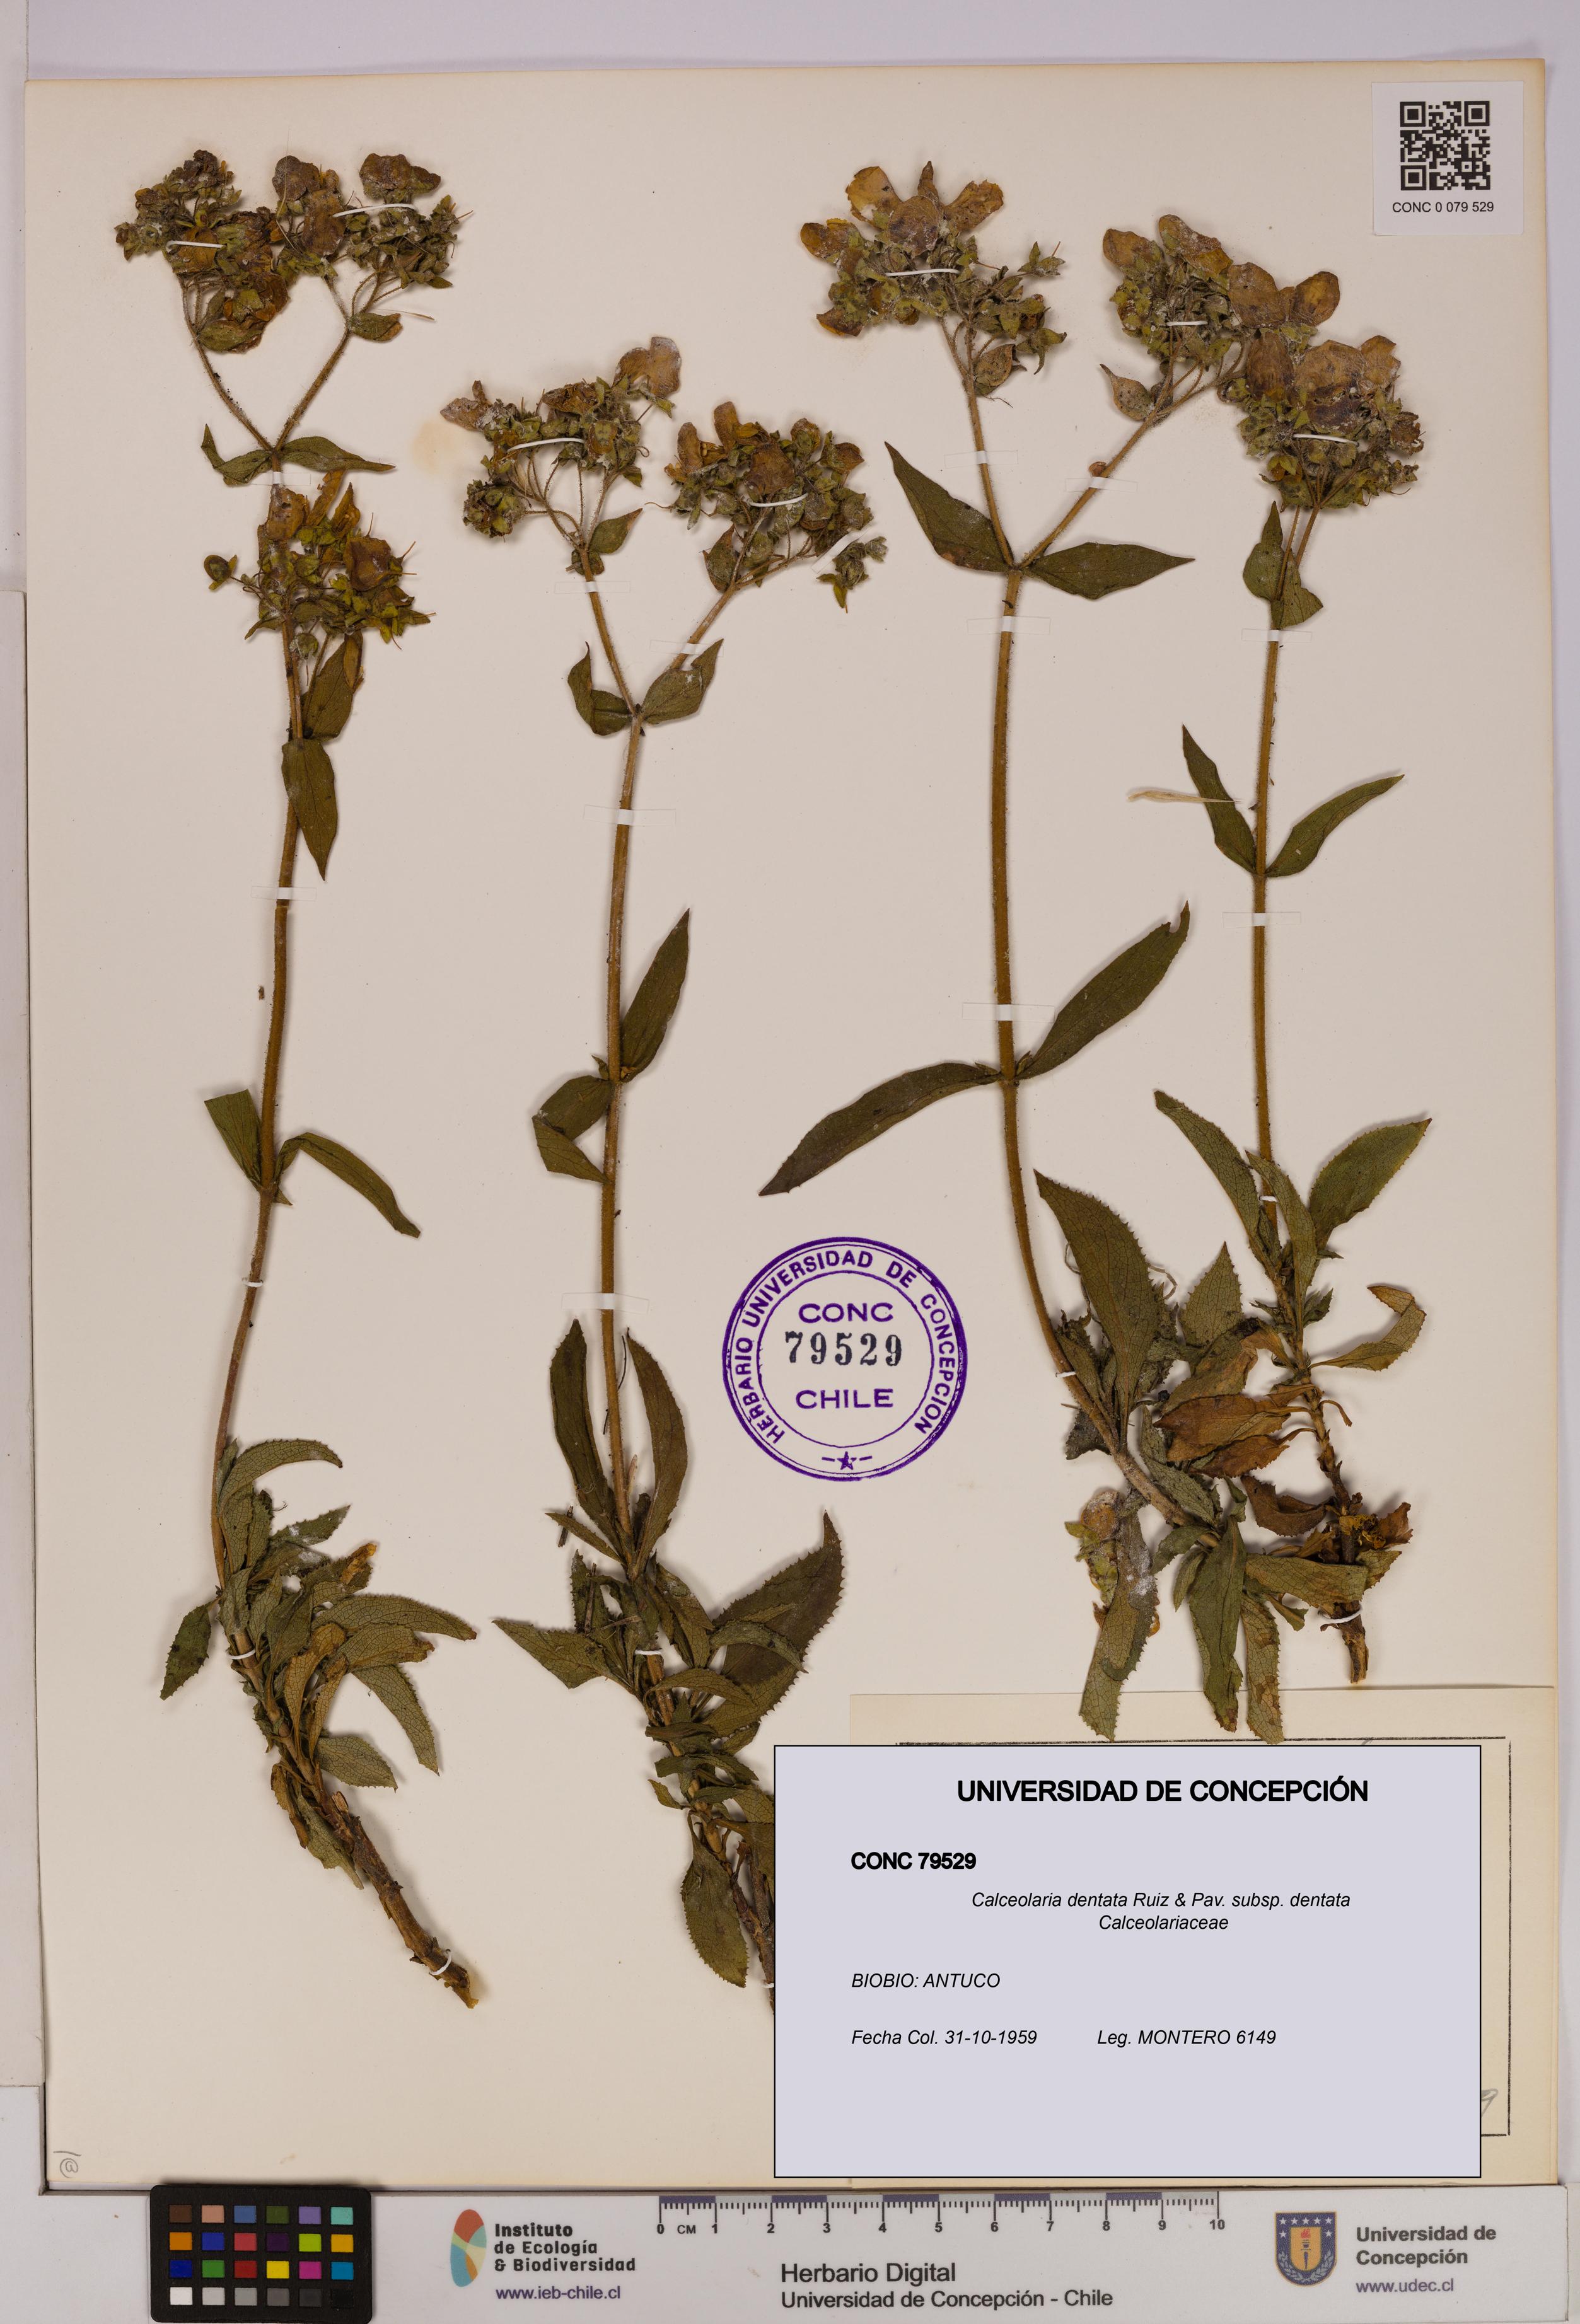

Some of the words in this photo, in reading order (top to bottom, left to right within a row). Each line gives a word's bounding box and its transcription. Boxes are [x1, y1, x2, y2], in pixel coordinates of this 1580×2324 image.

[1393, 202, 1431, 212] CONC
[1436, 202, 1442, 212] 0
[1447, 202, 1468, 212] 079
[1472, 202, 1494, 212] 529
[886, 1261, 917, 1288] DE
[742, 1250, 873, 1327] UNIVERSIDAD
[799, 1303, 893, 1323] CONC
[785, 1331, 902, 1367] 79529
[914, 1293, 955, 1433] CONCEPCION
[736, 1337, 785, 1443] HERBARIO
[796, 1389, 893, 1409] CHILE
[496, 2223, 572, 2236] Instituto
[657, 2224, 665, 2234] 0
[677, 2225, 695, 2234] CM
[712, 2223, 717, 2233] 1
[767, 2223, 774, 2233] 2
[823, 2223, 830, 2233] 3
[878, 2223, 886, 2233] 4
[935, 2223, 943, 2233] 5
[991, 2222, 998, 2232] 6
[1047, 2221, 1054, 2231] 7
[1103, 2221, 1110, 2231] 8
[1158, 2220, 1166, 2230] 9
[1210, 2219, 1225, 2229] 10
[1357, 2226, 1467, 2241] Universidad
[1474, 2226, 1496, 2240] de
[494, 2241, 514, 2254] de
[523, 2240, 597, 2256] Ecología
[495, 2259, 506, 2272] &
[513, 2258, 636, 2272] Biodiversidad
[1356, 2249, 1468, 2268] Concepción
[782, 2263, 878, 2282] Herbario
[887, 2263, 955, 2287] Digital
[496, 2286, 620, 2299] www.ieb-chile.cl
[1356, 2278, 1453, 2292] www.udec.cl
[782, 2291, 894, 2308] Universidad
[901, 2291, 924, 2307] de
[931, 2290, 1044, 2310] Concepción
[1064, 2289, 1113, 2306] Chile
